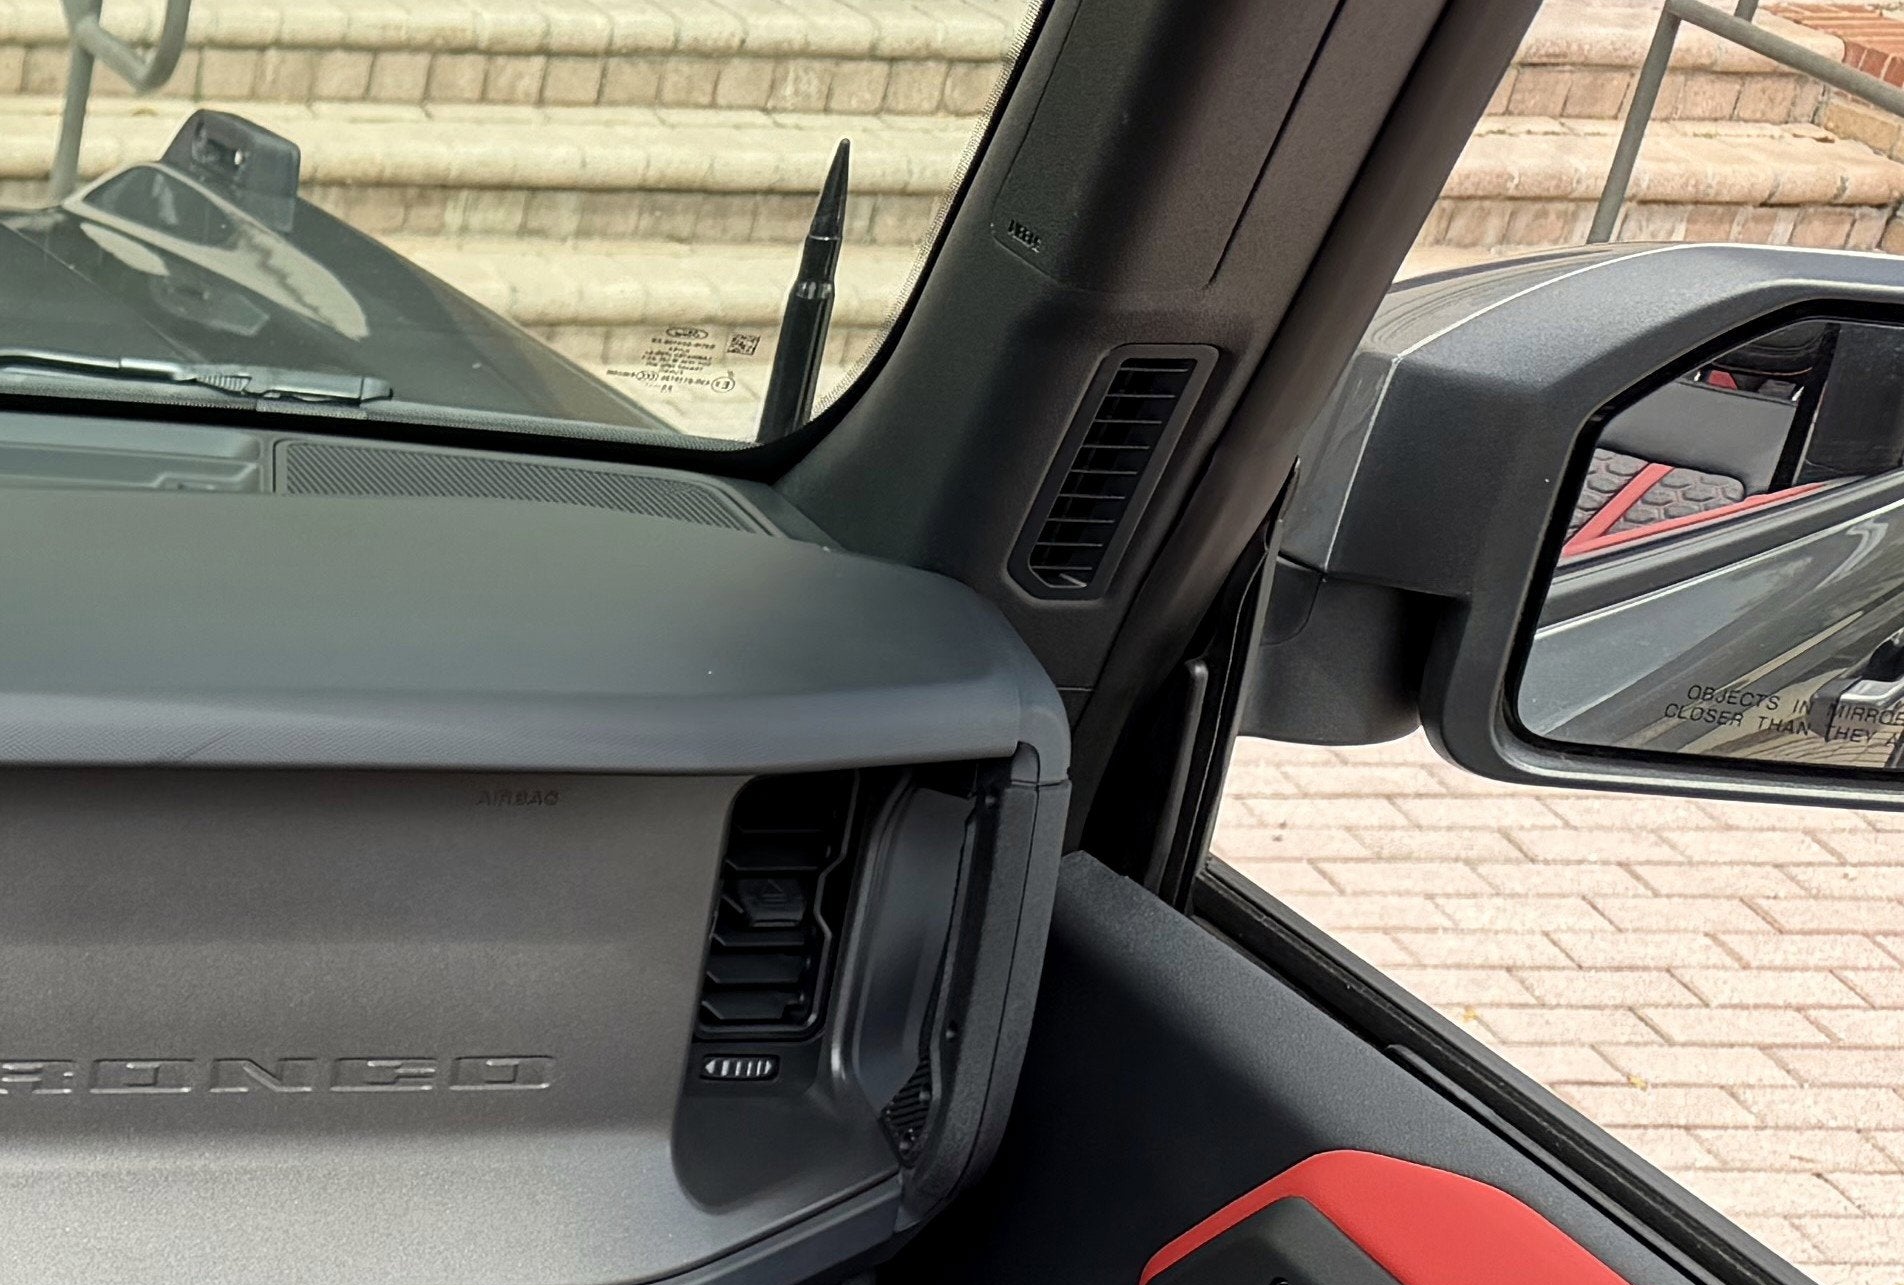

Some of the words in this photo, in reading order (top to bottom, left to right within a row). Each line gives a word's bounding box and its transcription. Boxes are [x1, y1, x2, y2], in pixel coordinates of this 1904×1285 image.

[1687, 684, 1780, 711] OBJECTS
[1792, 699, 1814, 715] IN
[1664, 703, 1744, 726] CLOSER
[1758, 716, 1811, 736] THAN
